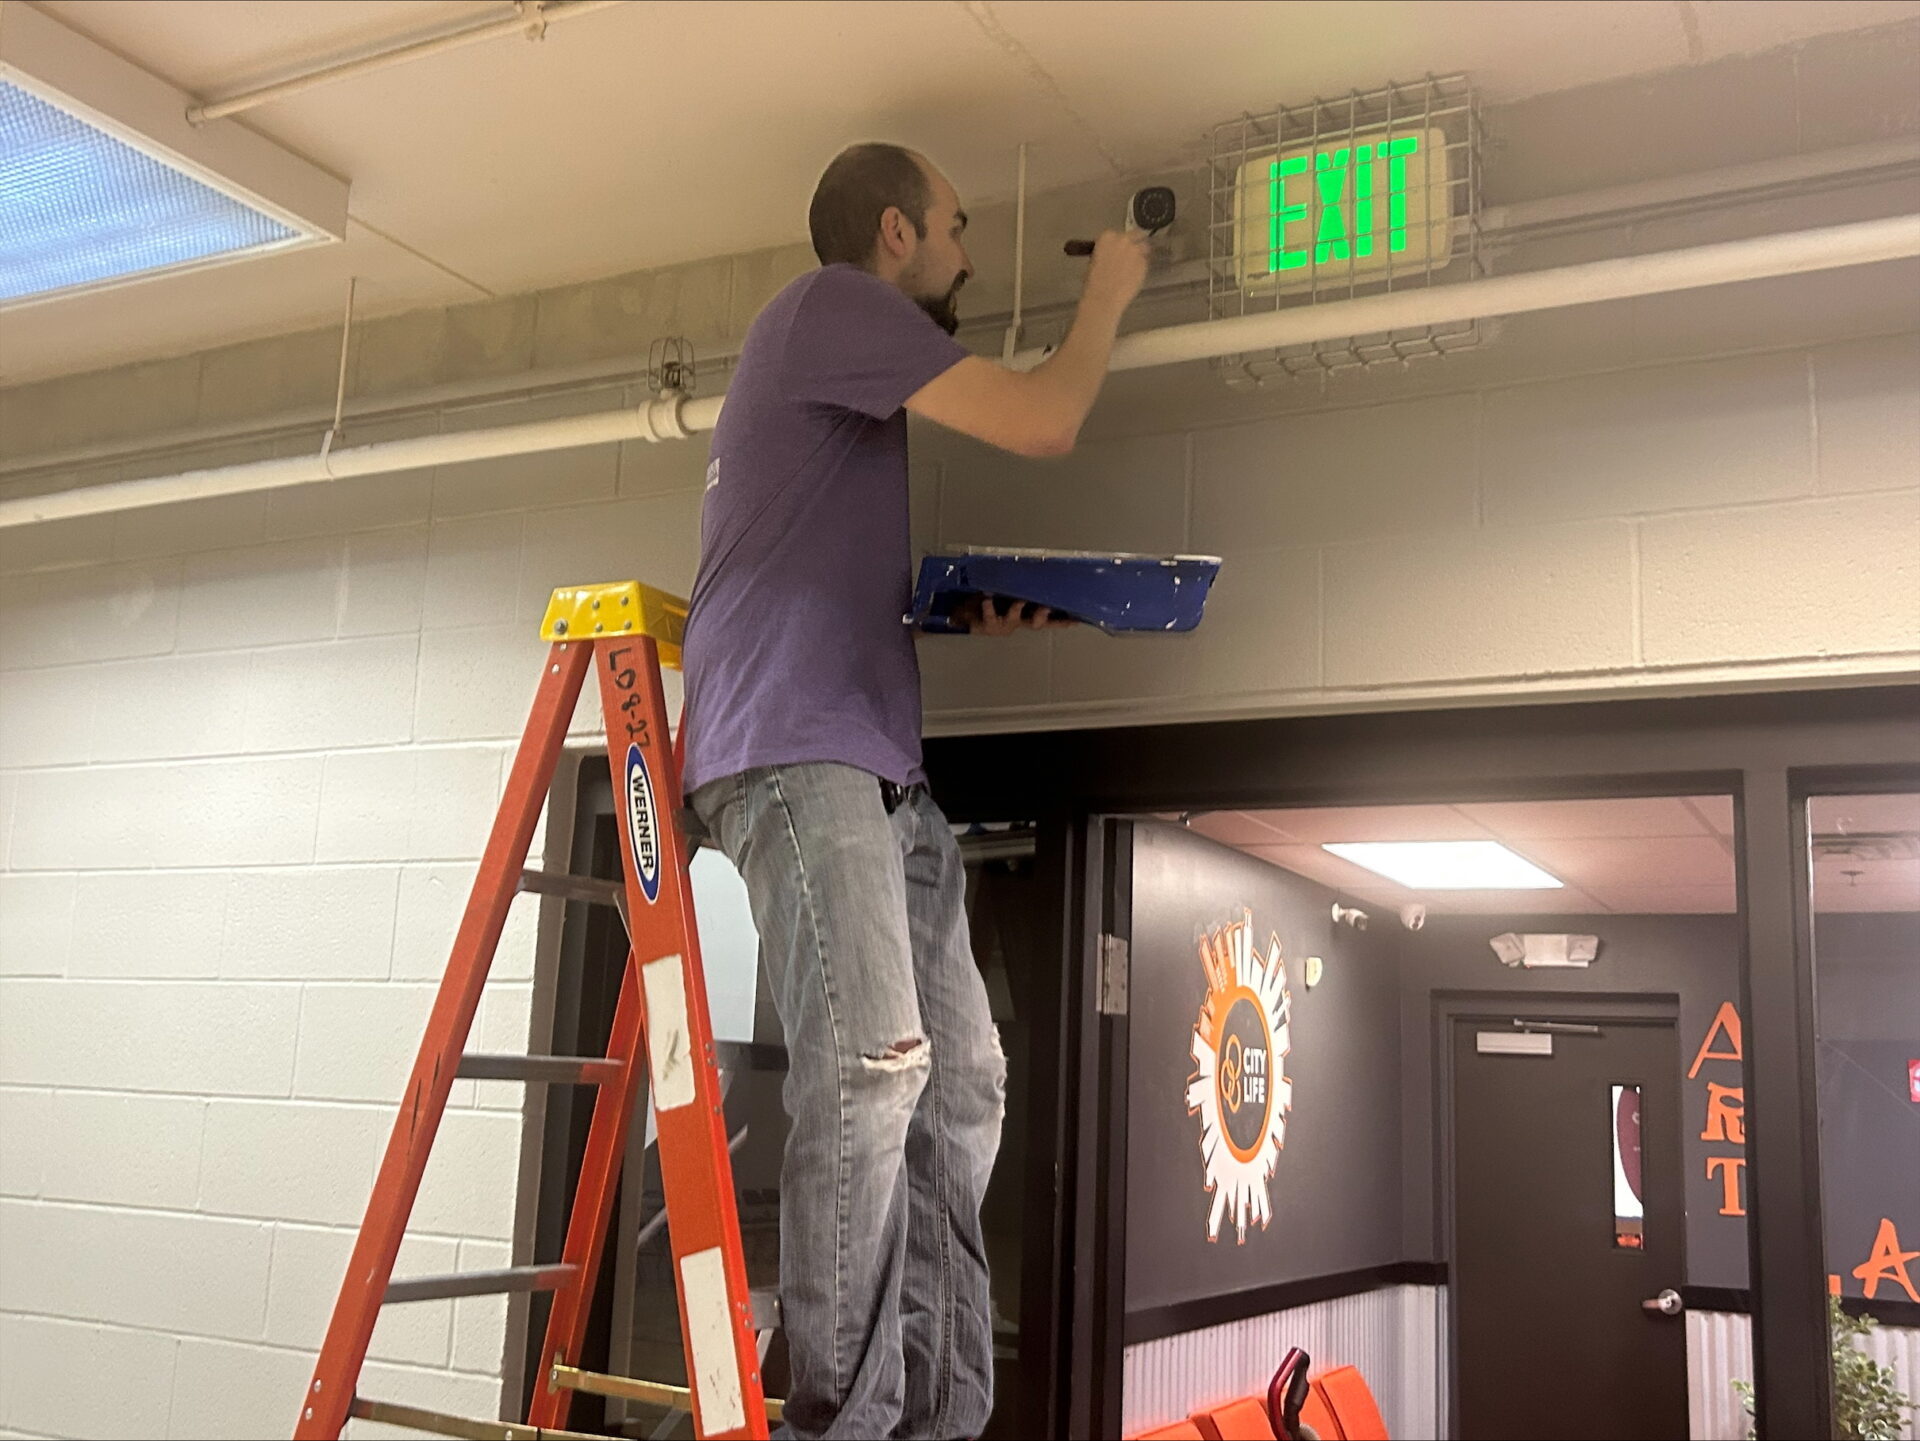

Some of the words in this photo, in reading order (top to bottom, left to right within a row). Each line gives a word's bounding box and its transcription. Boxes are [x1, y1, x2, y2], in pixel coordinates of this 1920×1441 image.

[1269, 136, 1417, 273] EXIT
[632, 774, 654, 869] WERNER
[1243, 1047, 1267, 1075] CITY
[1243, 1076, 1265, 1103] LIFE
